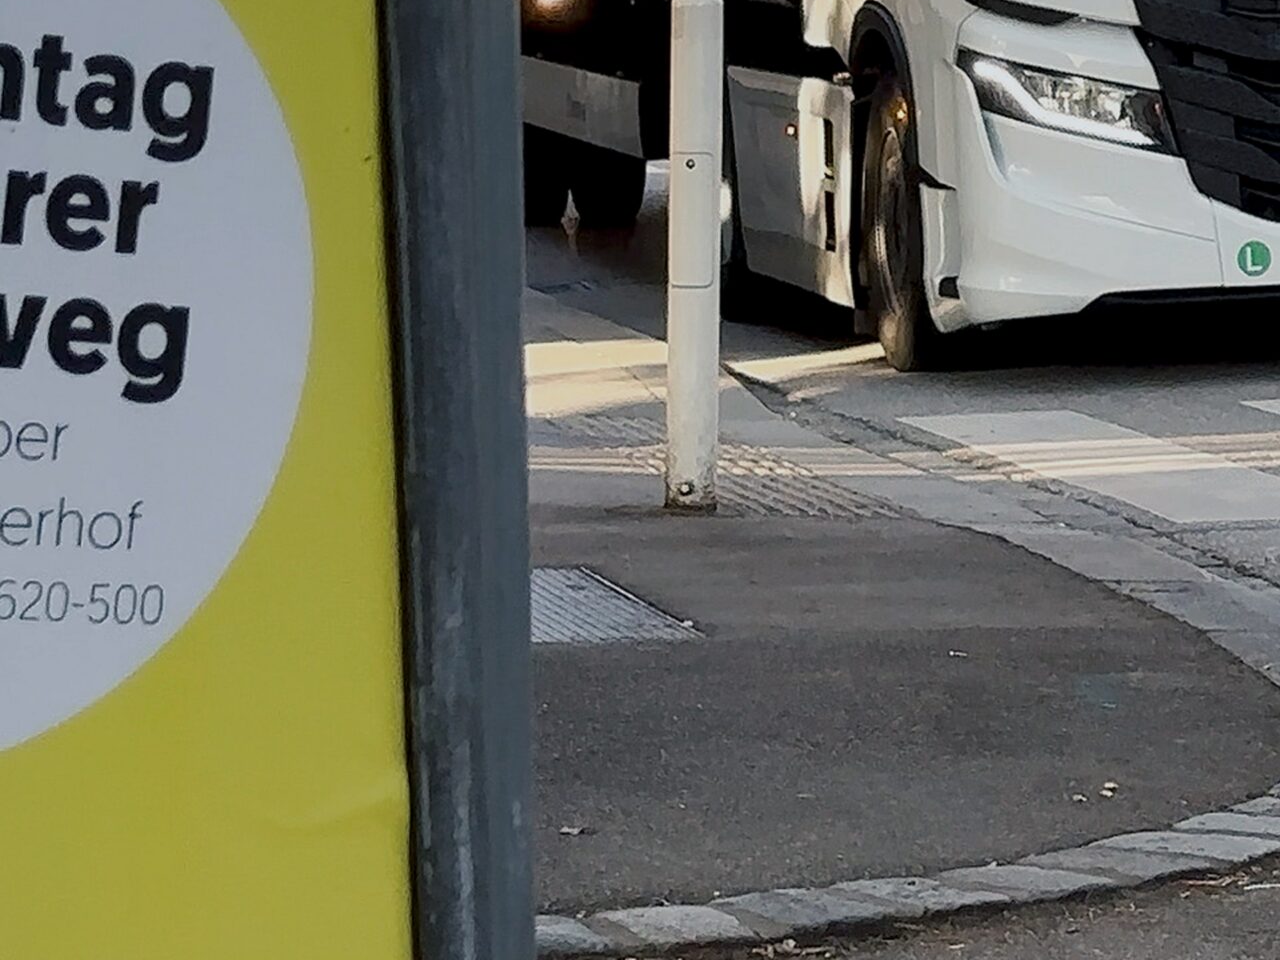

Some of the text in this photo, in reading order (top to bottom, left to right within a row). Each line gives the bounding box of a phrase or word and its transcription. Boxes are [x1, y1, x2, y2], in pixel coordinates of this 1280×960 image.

[1, 170, 160, 254] rer
[1246, 246, 1263, 271] L
[0, 497, 144, 550] erhof
[0, 579, 164, 625] 620-500
